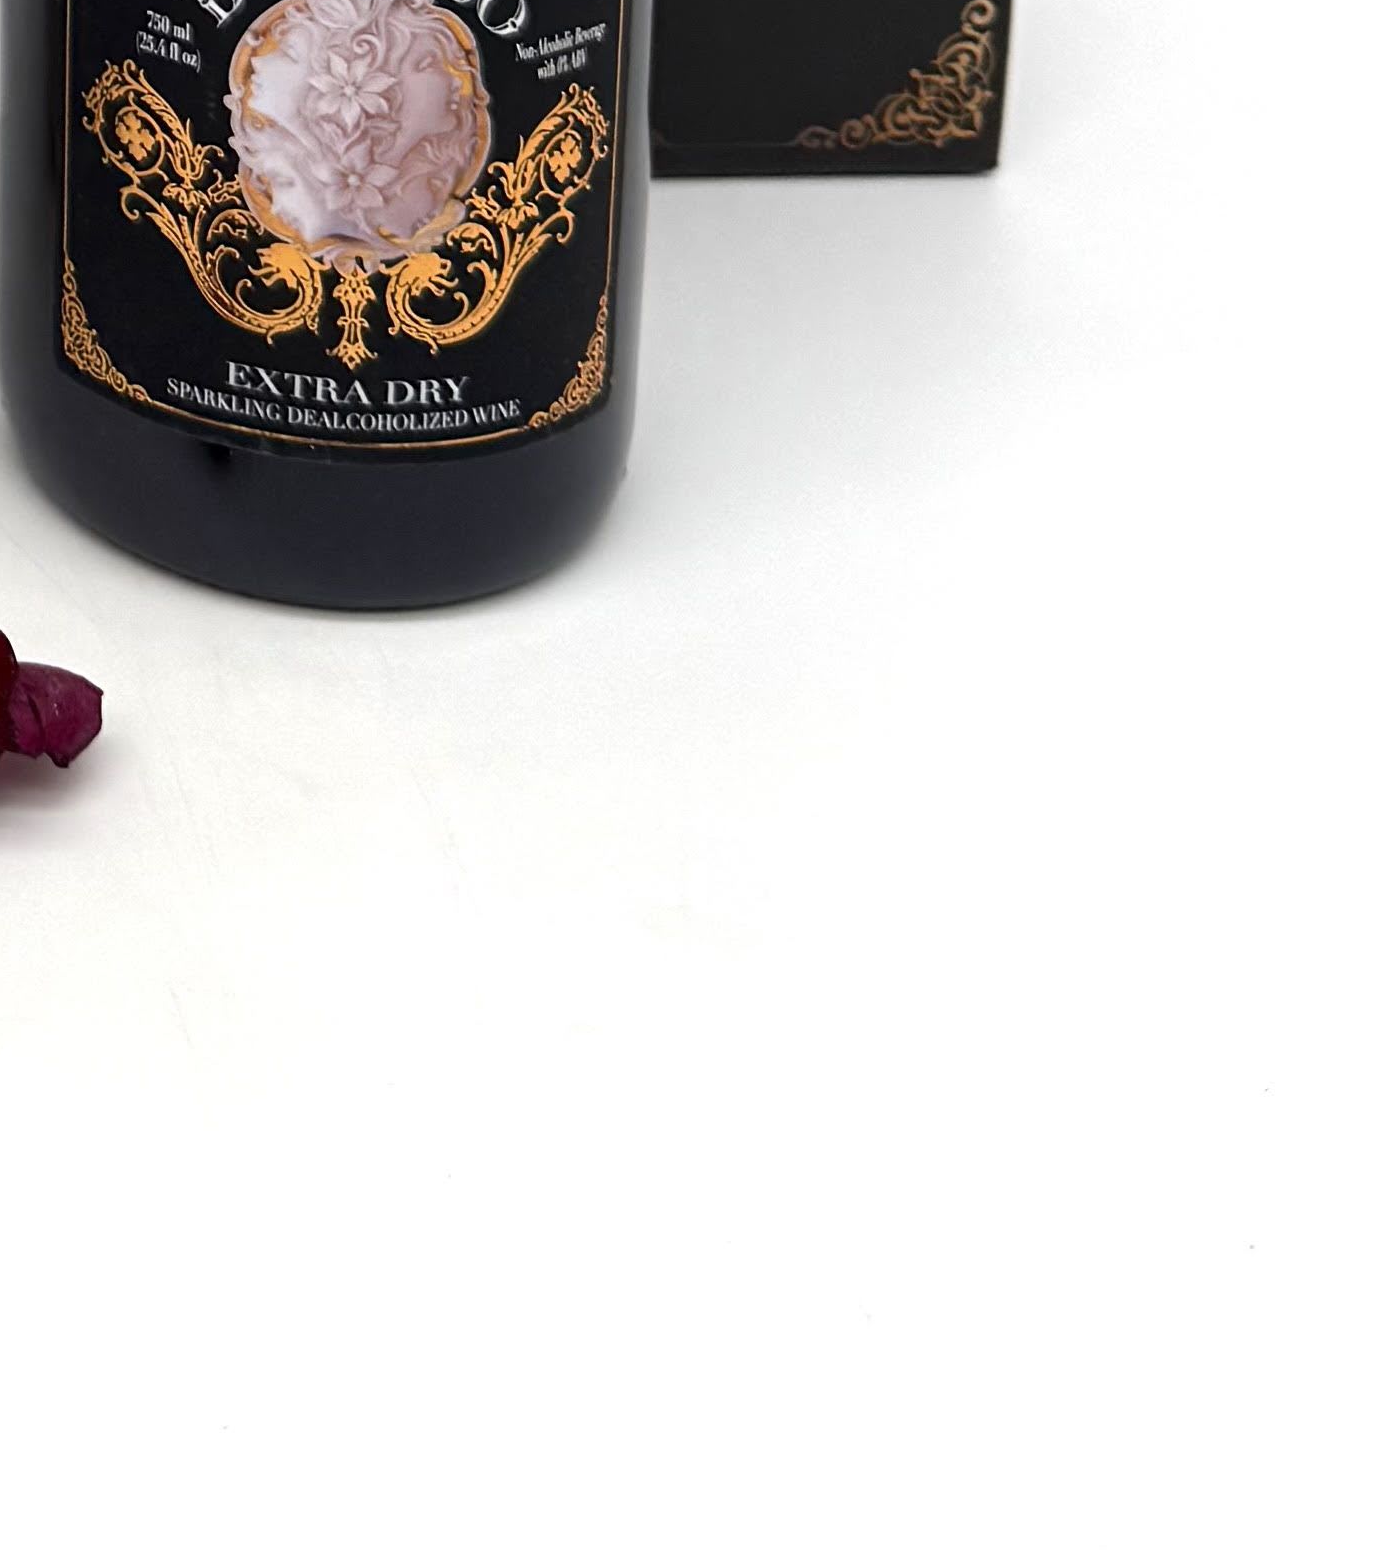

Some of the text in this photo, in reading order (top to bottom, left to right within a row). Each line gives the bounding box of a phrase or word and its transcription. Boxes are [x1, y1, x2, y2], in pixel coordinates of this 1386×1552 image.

[146, 9, 191, 42] 750 ml
[182, 48, 201, 74] oz)
[226, 361, 470, 405] EXTRA DRY
[166, 377, 521, 432] SPARKLING DEALCOHOLIZED WINE
